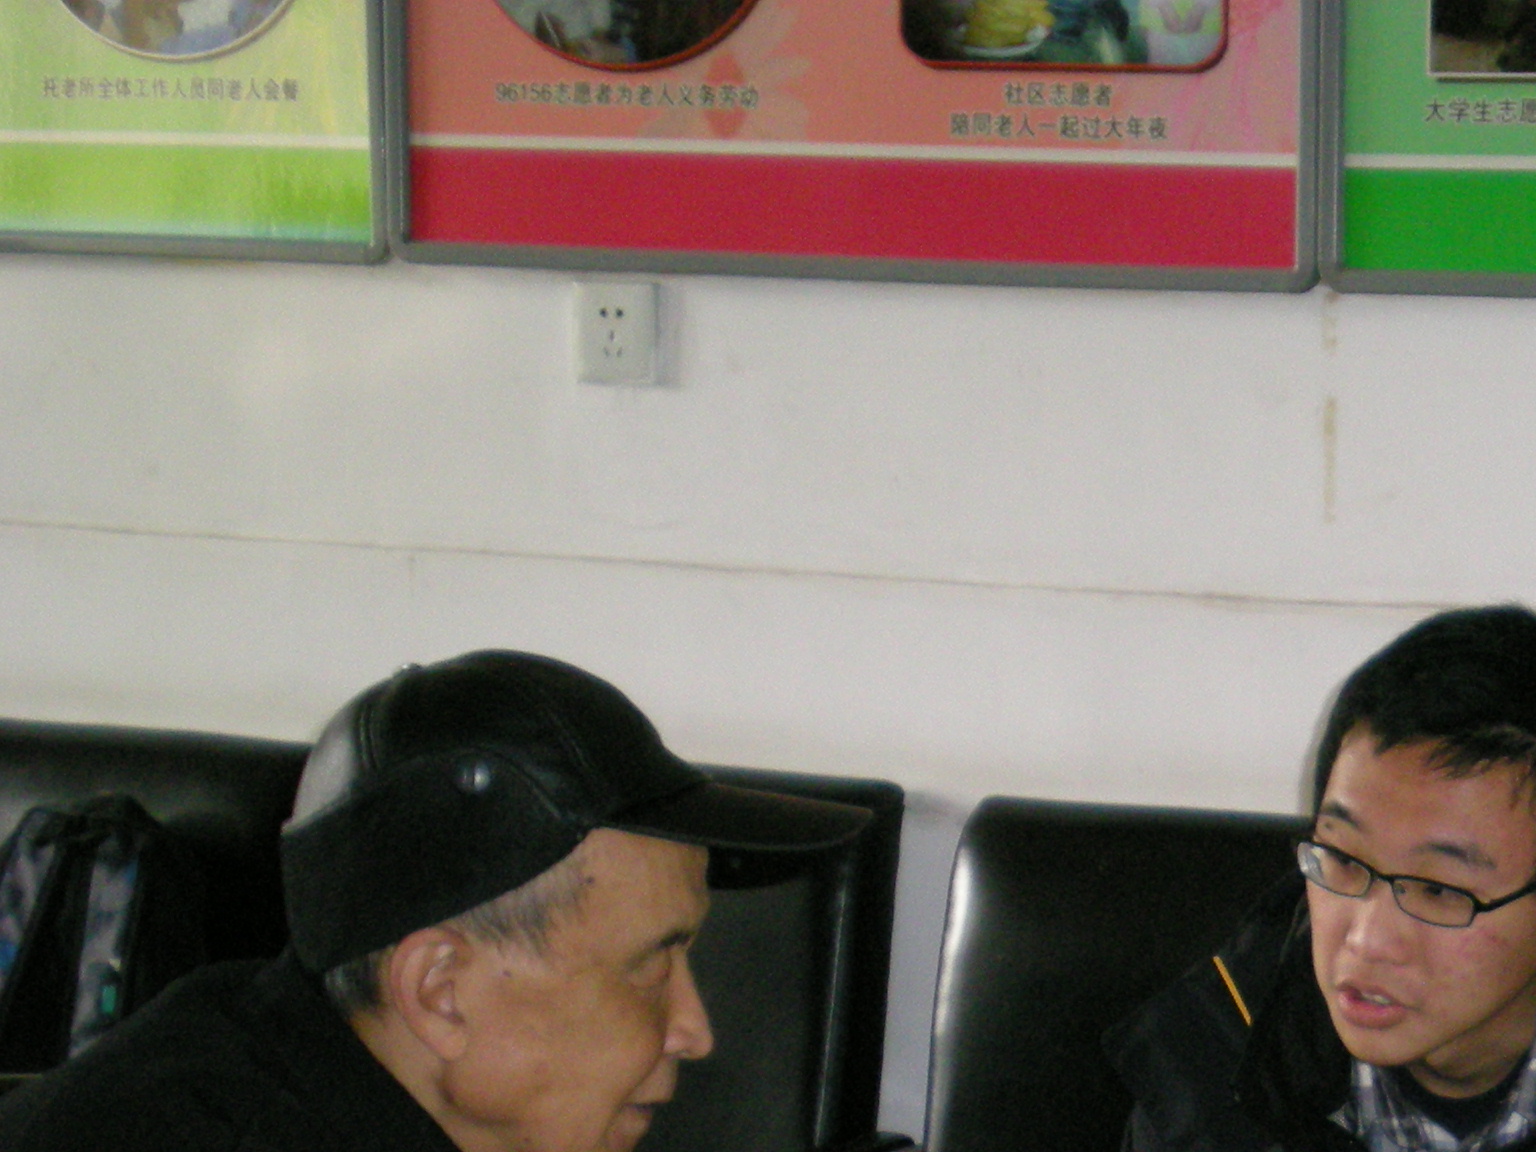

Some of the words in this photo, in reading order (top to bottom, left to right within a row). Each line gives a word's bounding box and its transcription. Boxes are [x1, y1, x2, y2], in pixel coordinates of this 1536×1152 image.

[1004, 82, 1113, 107] 社区志愿者
[951, 113, 1168, 139] 陪同老人一起过大年夜
